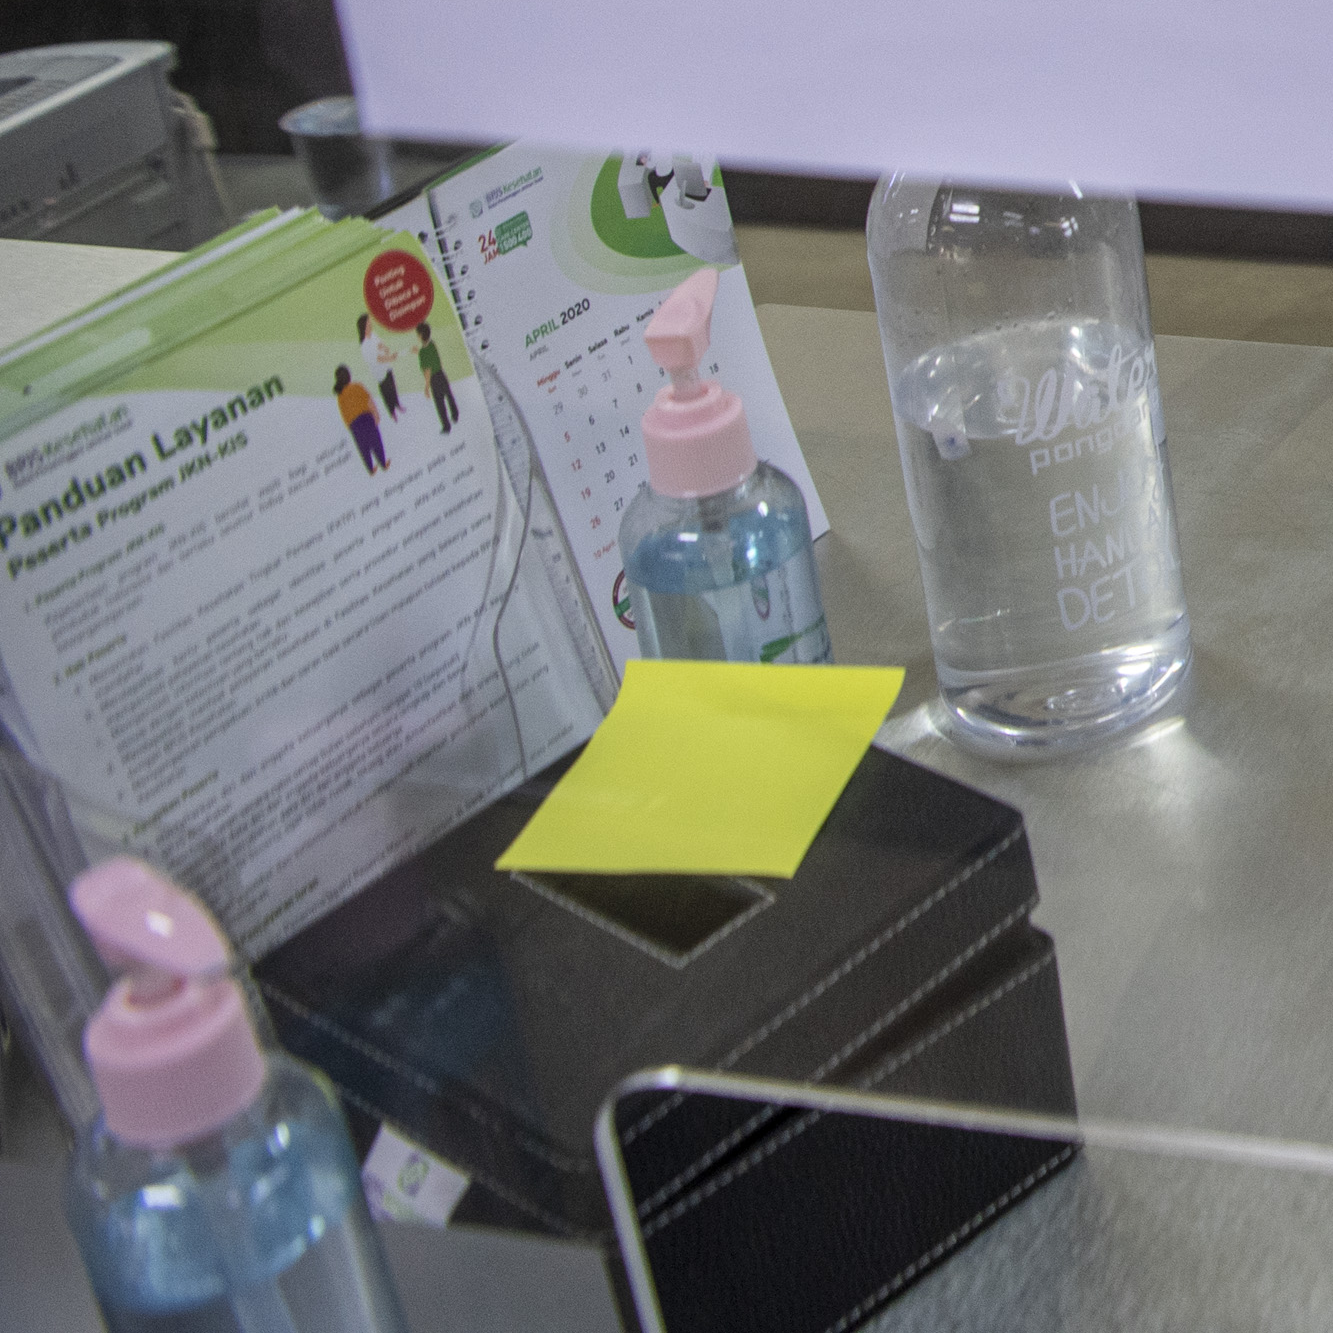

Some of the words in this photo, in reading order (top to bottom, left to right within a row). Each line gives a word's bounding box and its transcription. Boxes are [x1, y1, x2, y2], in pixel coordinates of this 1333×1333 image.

[478, 229, 496, 253] 24
[525, 319, 560, 349] APRIL
[560, 298, 591, 326] 2020
[614, 324, 630, 337] Rabu
[553, 401, 564, 415] 29
[577, 384, 588, 399] 30
[602, 369, 611, 383] 31
[627, 355, 633, 365] 1
[563, 431, 571, 443] 5
[588, 415, 595, 426] 6
[612, 398, 618, 409] 7
[636, 382, 642, 393] 8
[659, 366, 665, 377] 9
[0, 450, 148, 552] Panduan
[151, 374, 284, 461] Layanan
[571, 458, 582, 472] 12
[596, 441, 606, 455] 13
[619, 425, 630, 438] 14
[581, 487, 591, 500] 19
[604, 470, 615, 484] 20
[628, 453, 639, 467] 21
[7, 522, 93, 581] Peserta
[96, 474, 176, 529] Program
[614, 497, 624, 511] 27
